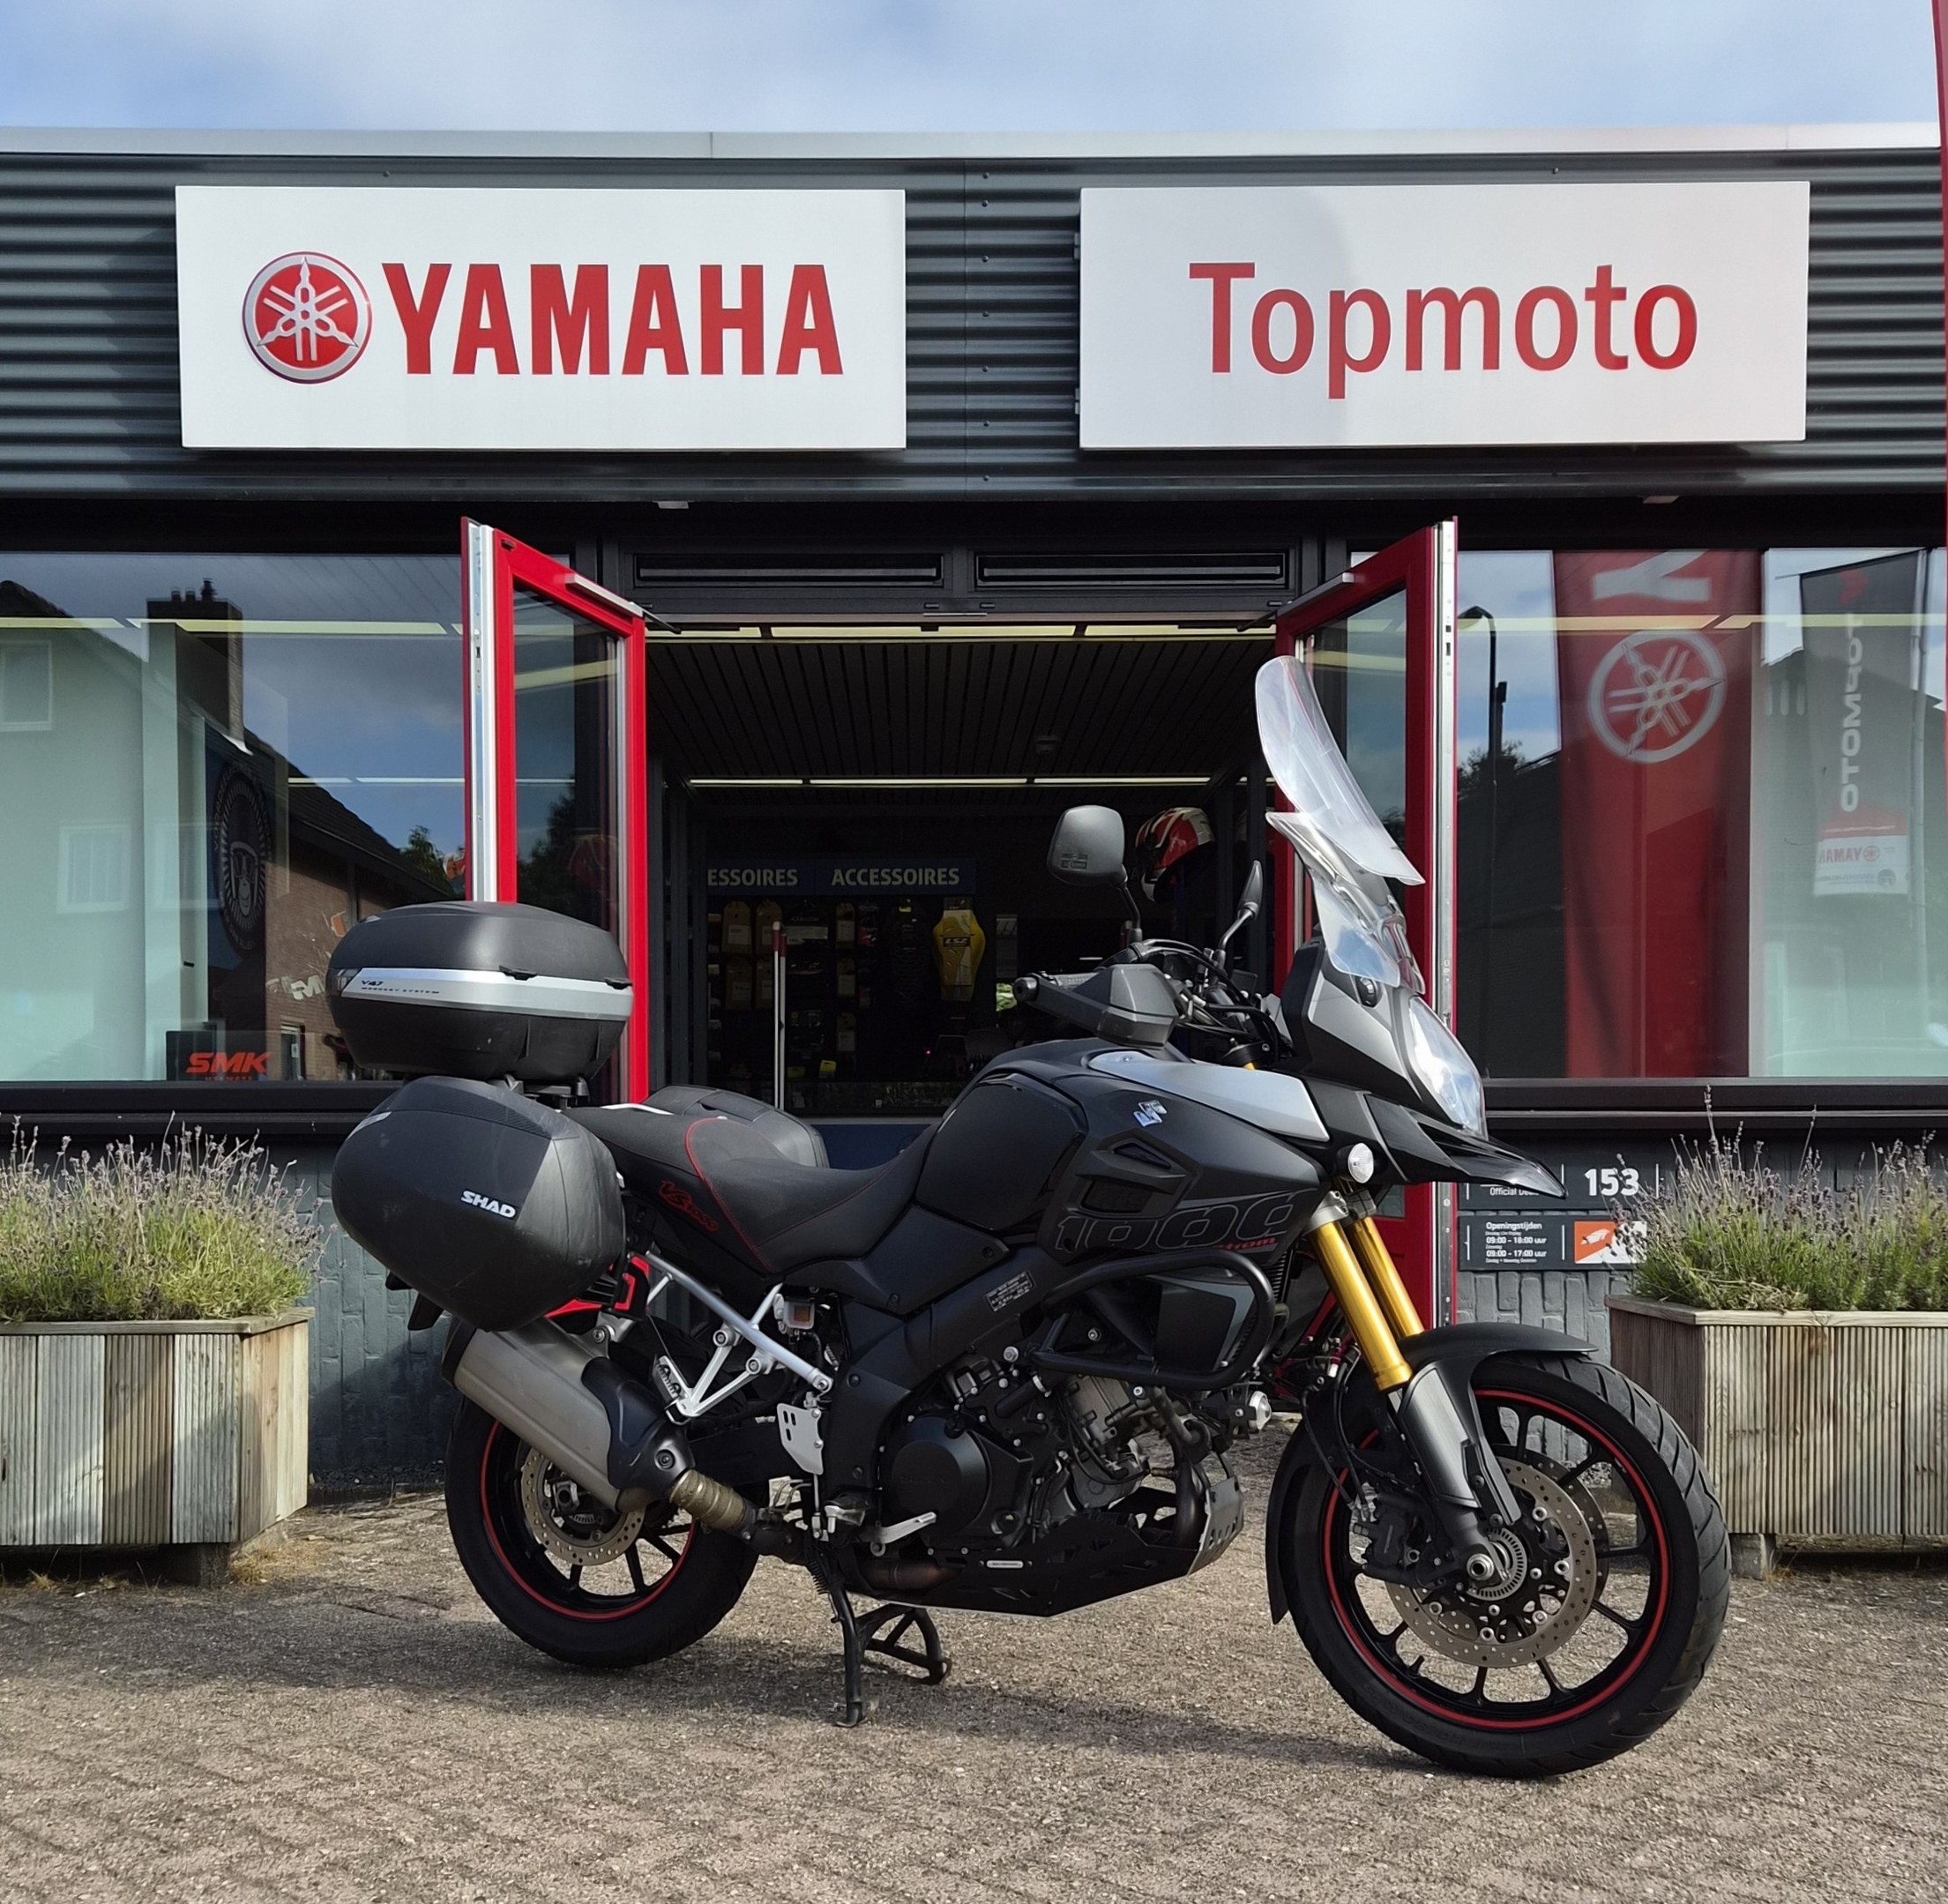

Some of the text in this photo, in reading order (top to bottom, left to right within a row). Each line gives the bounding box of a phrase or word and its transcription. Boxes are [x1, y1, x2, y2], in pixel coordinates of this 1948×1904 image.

[382, 263, 844, 376] YAMAHA
[1189, 262, 1698, 399] Topmoto
[831, 868, 959, 885] ACCESSOIRES
[185, 1052, 272, 1073] SMK
[1489, 1187, 1517, 1196] Official
[1585, 1168, 1639, 1196] 153
[460, 1190, 516, 1218] SHAD
[1486, 1221, 1542, 1231] Openingstijden
